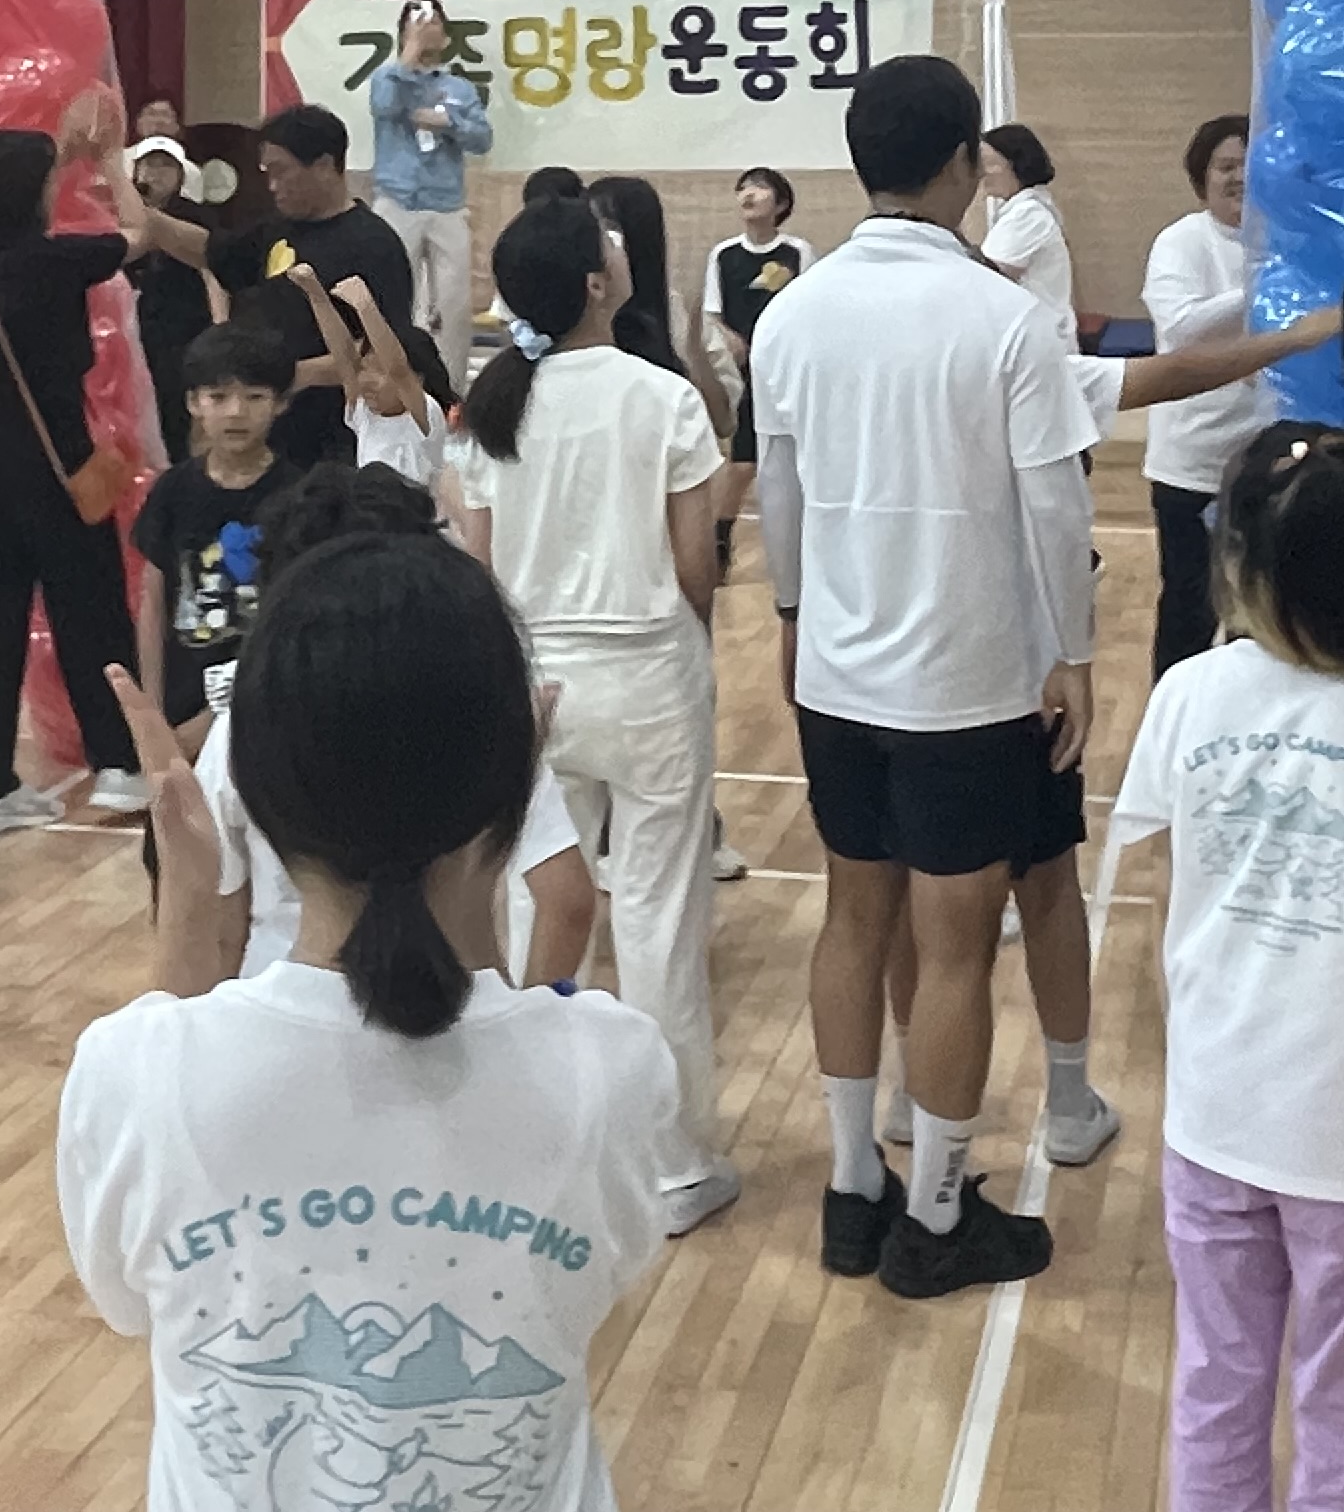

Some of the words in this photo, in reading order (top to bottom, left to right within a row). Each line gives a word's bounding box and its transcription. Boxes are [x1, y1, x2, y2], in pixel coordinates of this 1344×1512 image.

[1246, 732, 1280, 752] GO
[160, 1193, 287, 1272] LET'S
[299, 1184, 376, 1229] GO
[390, 1187, 593, 1272] CAMPING
